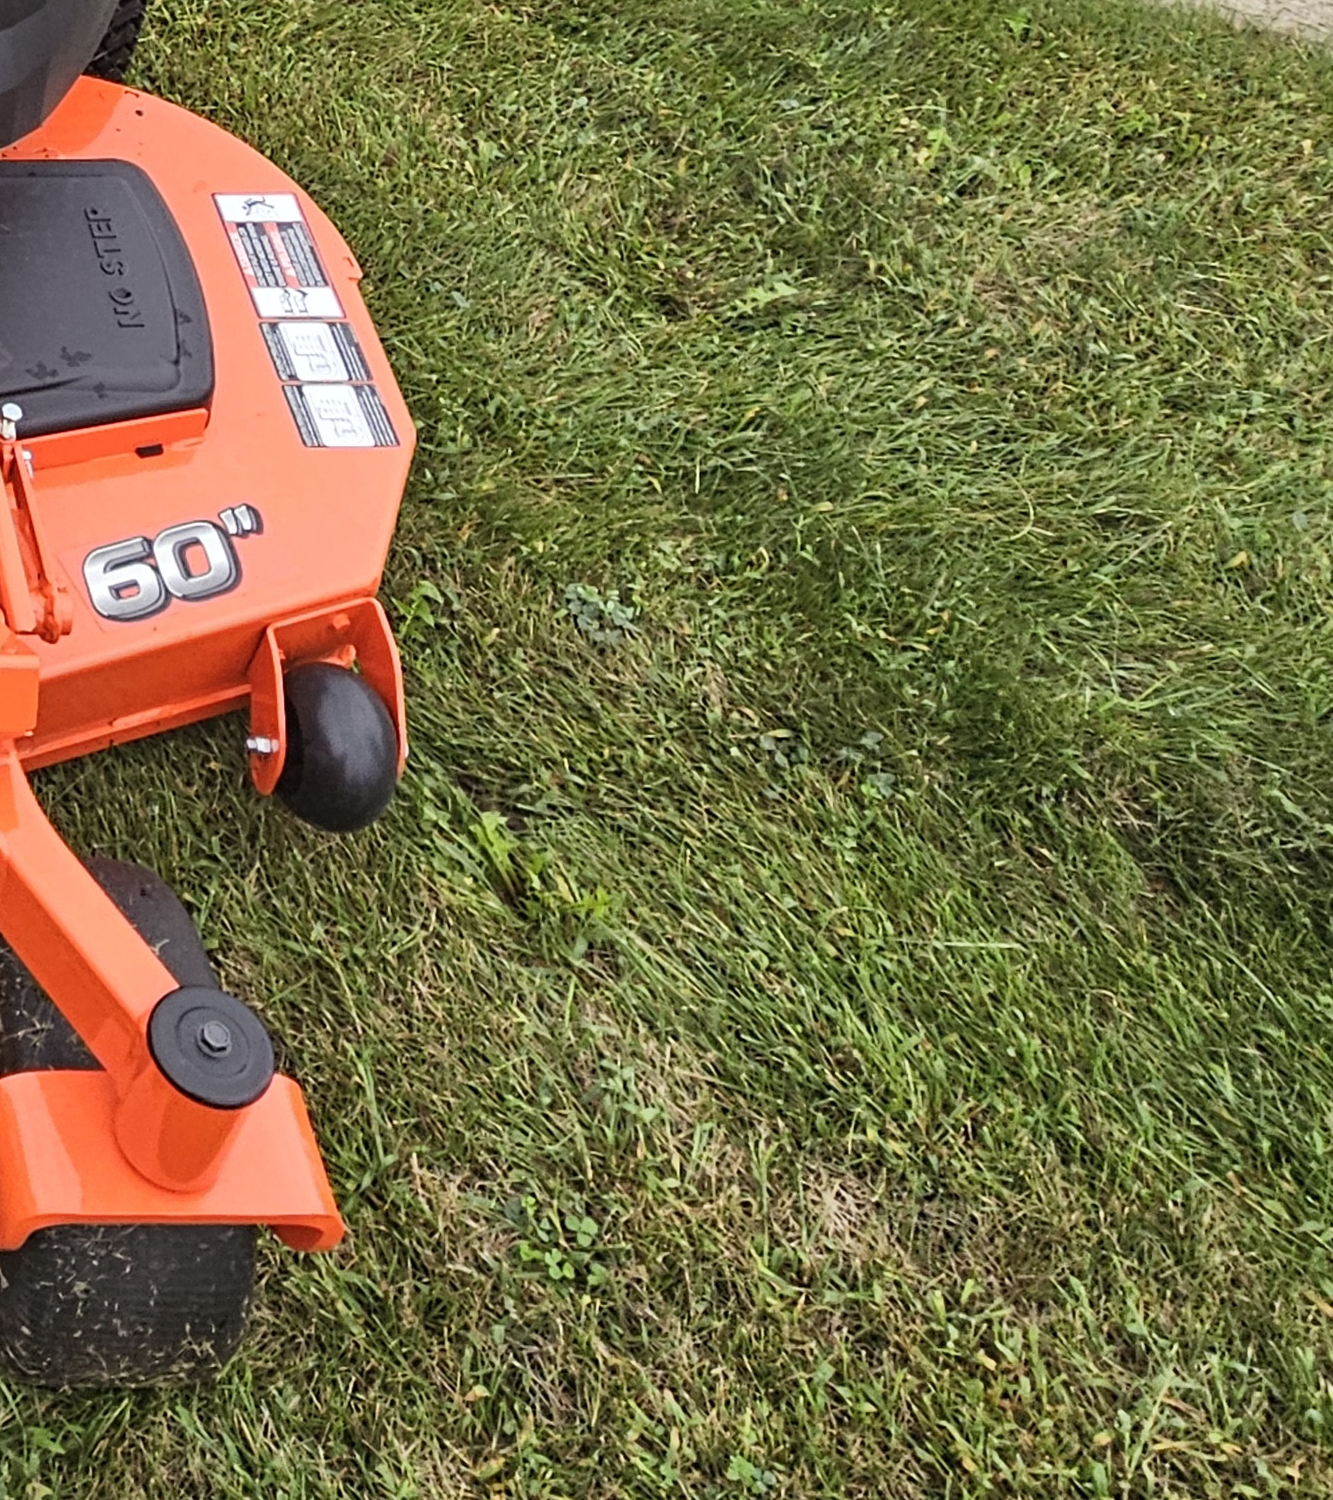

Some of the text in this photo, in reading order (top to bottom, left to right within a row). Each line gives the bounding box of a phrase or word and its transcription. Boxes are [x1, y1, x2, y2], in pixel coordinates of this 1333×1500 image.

[83, 206, 146, 329] NO STEP
[81, 503, 264, 623] 60"
